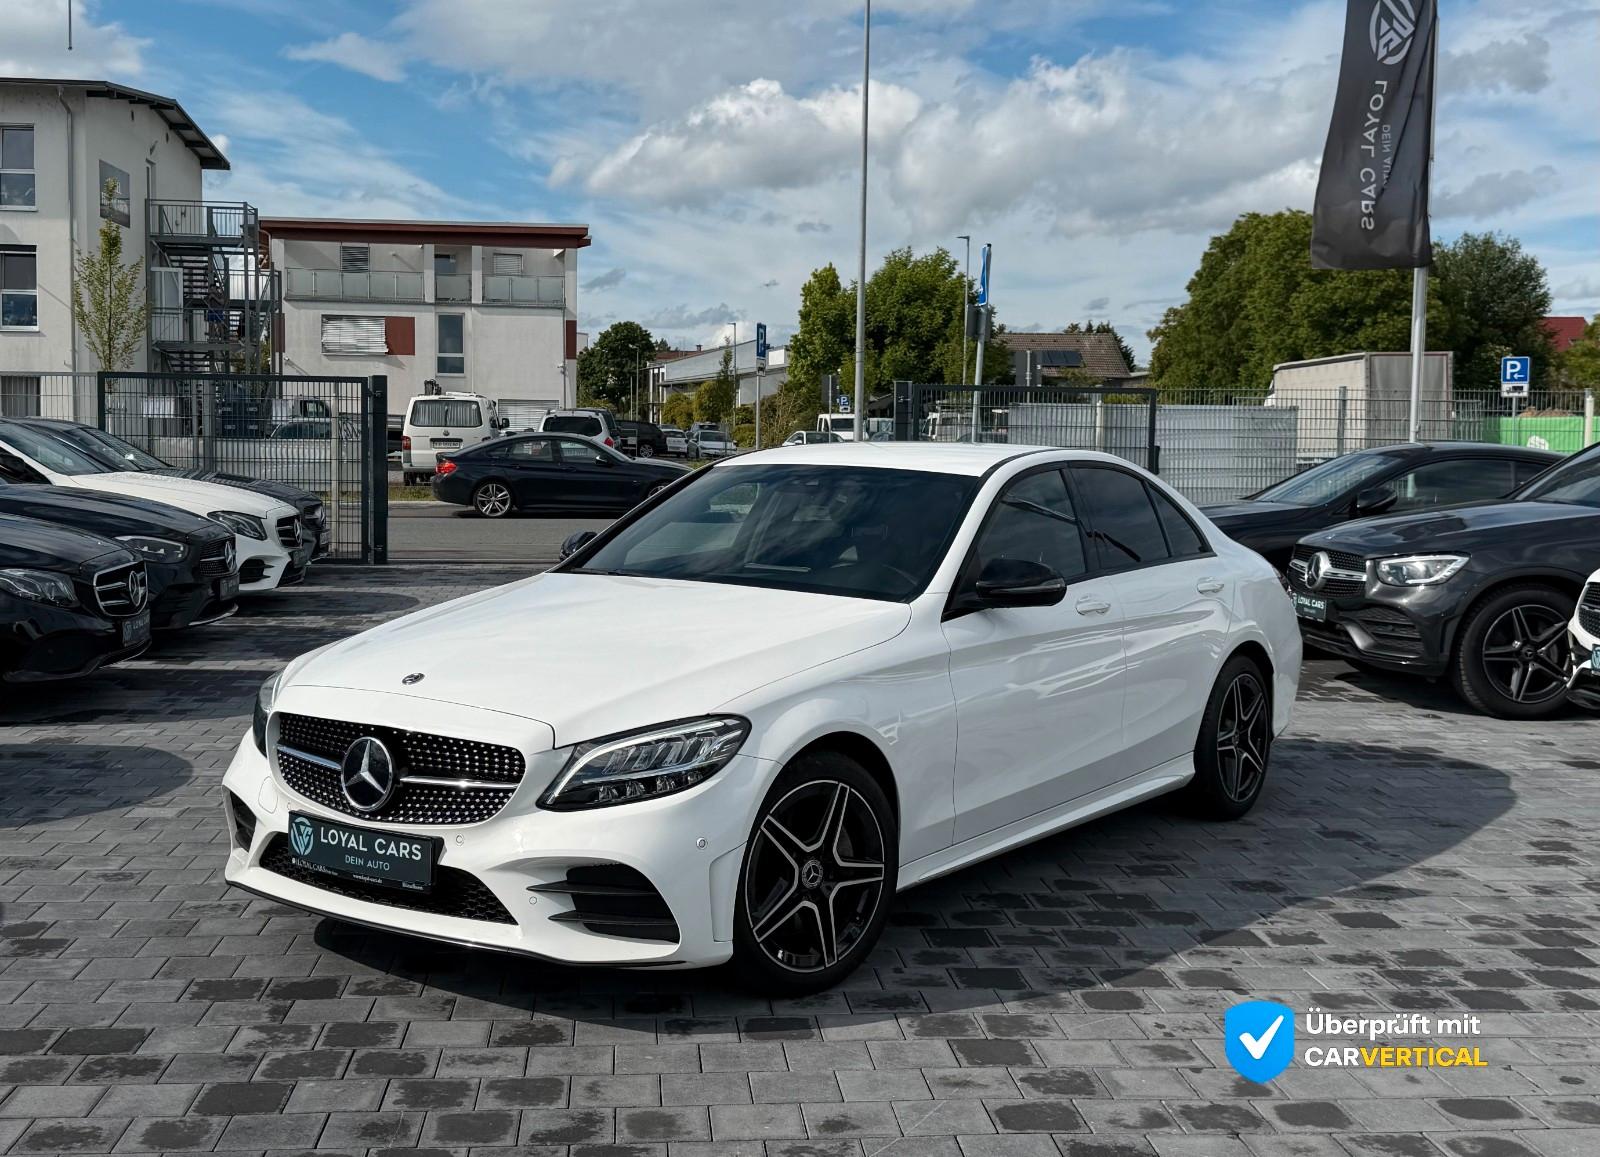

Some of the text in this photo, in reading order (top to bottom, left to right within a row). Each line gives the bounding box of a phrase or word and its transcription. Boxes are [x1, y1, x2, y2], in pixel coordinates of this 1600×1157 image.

[1506, 360, 1521, 380] P
[320, 826, 422, 861] LOYAL CARS
[345, 854, 390, 871] DEIN AUTO
